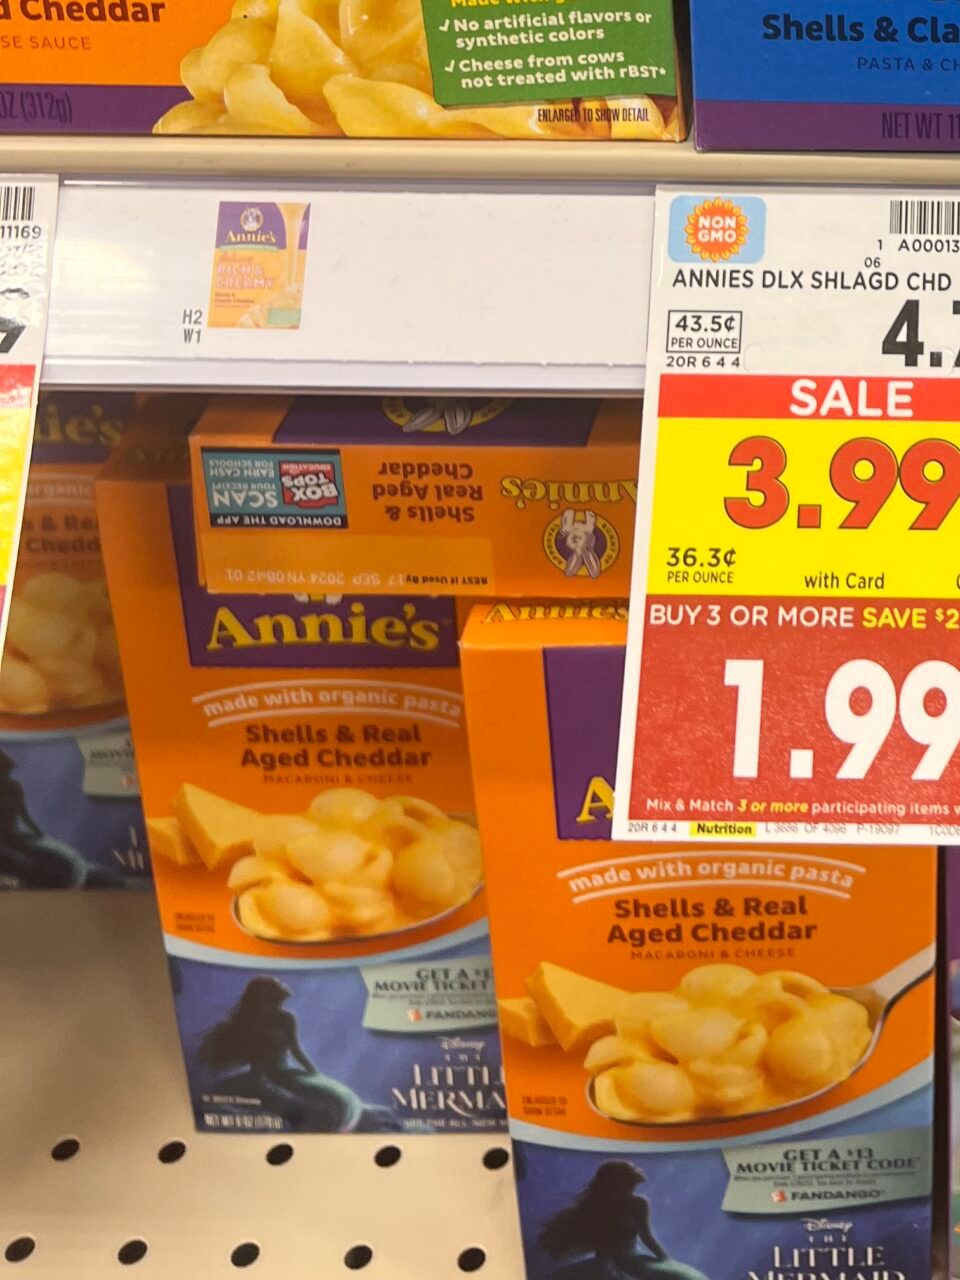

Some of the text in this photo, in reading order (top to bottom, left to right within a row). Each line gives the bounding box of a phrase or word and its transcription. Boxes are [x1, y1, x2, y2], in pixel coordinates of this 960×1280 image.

[763, 14, 864, 42] Shells
[873, 15, 899, 43] &
[857, 56, 917, 72] PASTA
[921, 57, 934, 72] &
[881, 112, 910, 141] NET
[912, 113, 941, 141] WT
[698, 215, 736, 230] NON
[698, 229, 736, 244] GMO
[877, 239, 882, 250] 1
[864, 257, 881, 268] 06
[672, 269, 952, 291] ANNIES DLX SHLAGD CHD
[183, 310, 203, 325] H2
[675, 314, 735, 333] 43.5¢
[183, 330, 201, 343] W1
[671, 337, 738, 349] PER OUNCE
[702, 356, 711, 367] 6
[716, 356, 726, 368] 4
[730, 356, 741, 368] 4
[789, 379, 914, 418] SALE
[281, 472, 329, 488] TOPS
[212, 490, 278, 508] SCAN
[292, 484, 339, 502] BOX
[216, 515, 342, 526] DOWNLOAD THE APP
[666, 547, 736, 569] 36.3¢
[667, 571, 733, 584] PER OUNCE
[804, 572, 885, 590] with Card
[649, 605, 702, 626] BUY
[706, 606, 721, 626] 3
[729, 606, 768, 627] OR
[777, 606, 854, 627] MORE
[862, 608, 926, 629] SAVE
[934, 608, 960, 630] $2
[206, 602, 440, 651] Annie's
[646, 799, 672, 811] Mix
[675, 799, 685, 811] &
[690, 799, 733, 812] Match
[737, 799, 747, 812] 3
[751, 801, 765, 813] or
[770, 801, 809, 813] more
[812, 801, 905, 819] participating
[910, 802, 950, 816] items
[697, 824, 752, 835] Nutrition
[613, 896, 808, 920] Shells & Real
[607, 920, 818, 947] Aged Cheddar
[737, 1161, 794, 1174] MOVIE
[791, 1190, 881, 1200] FANDANGO
